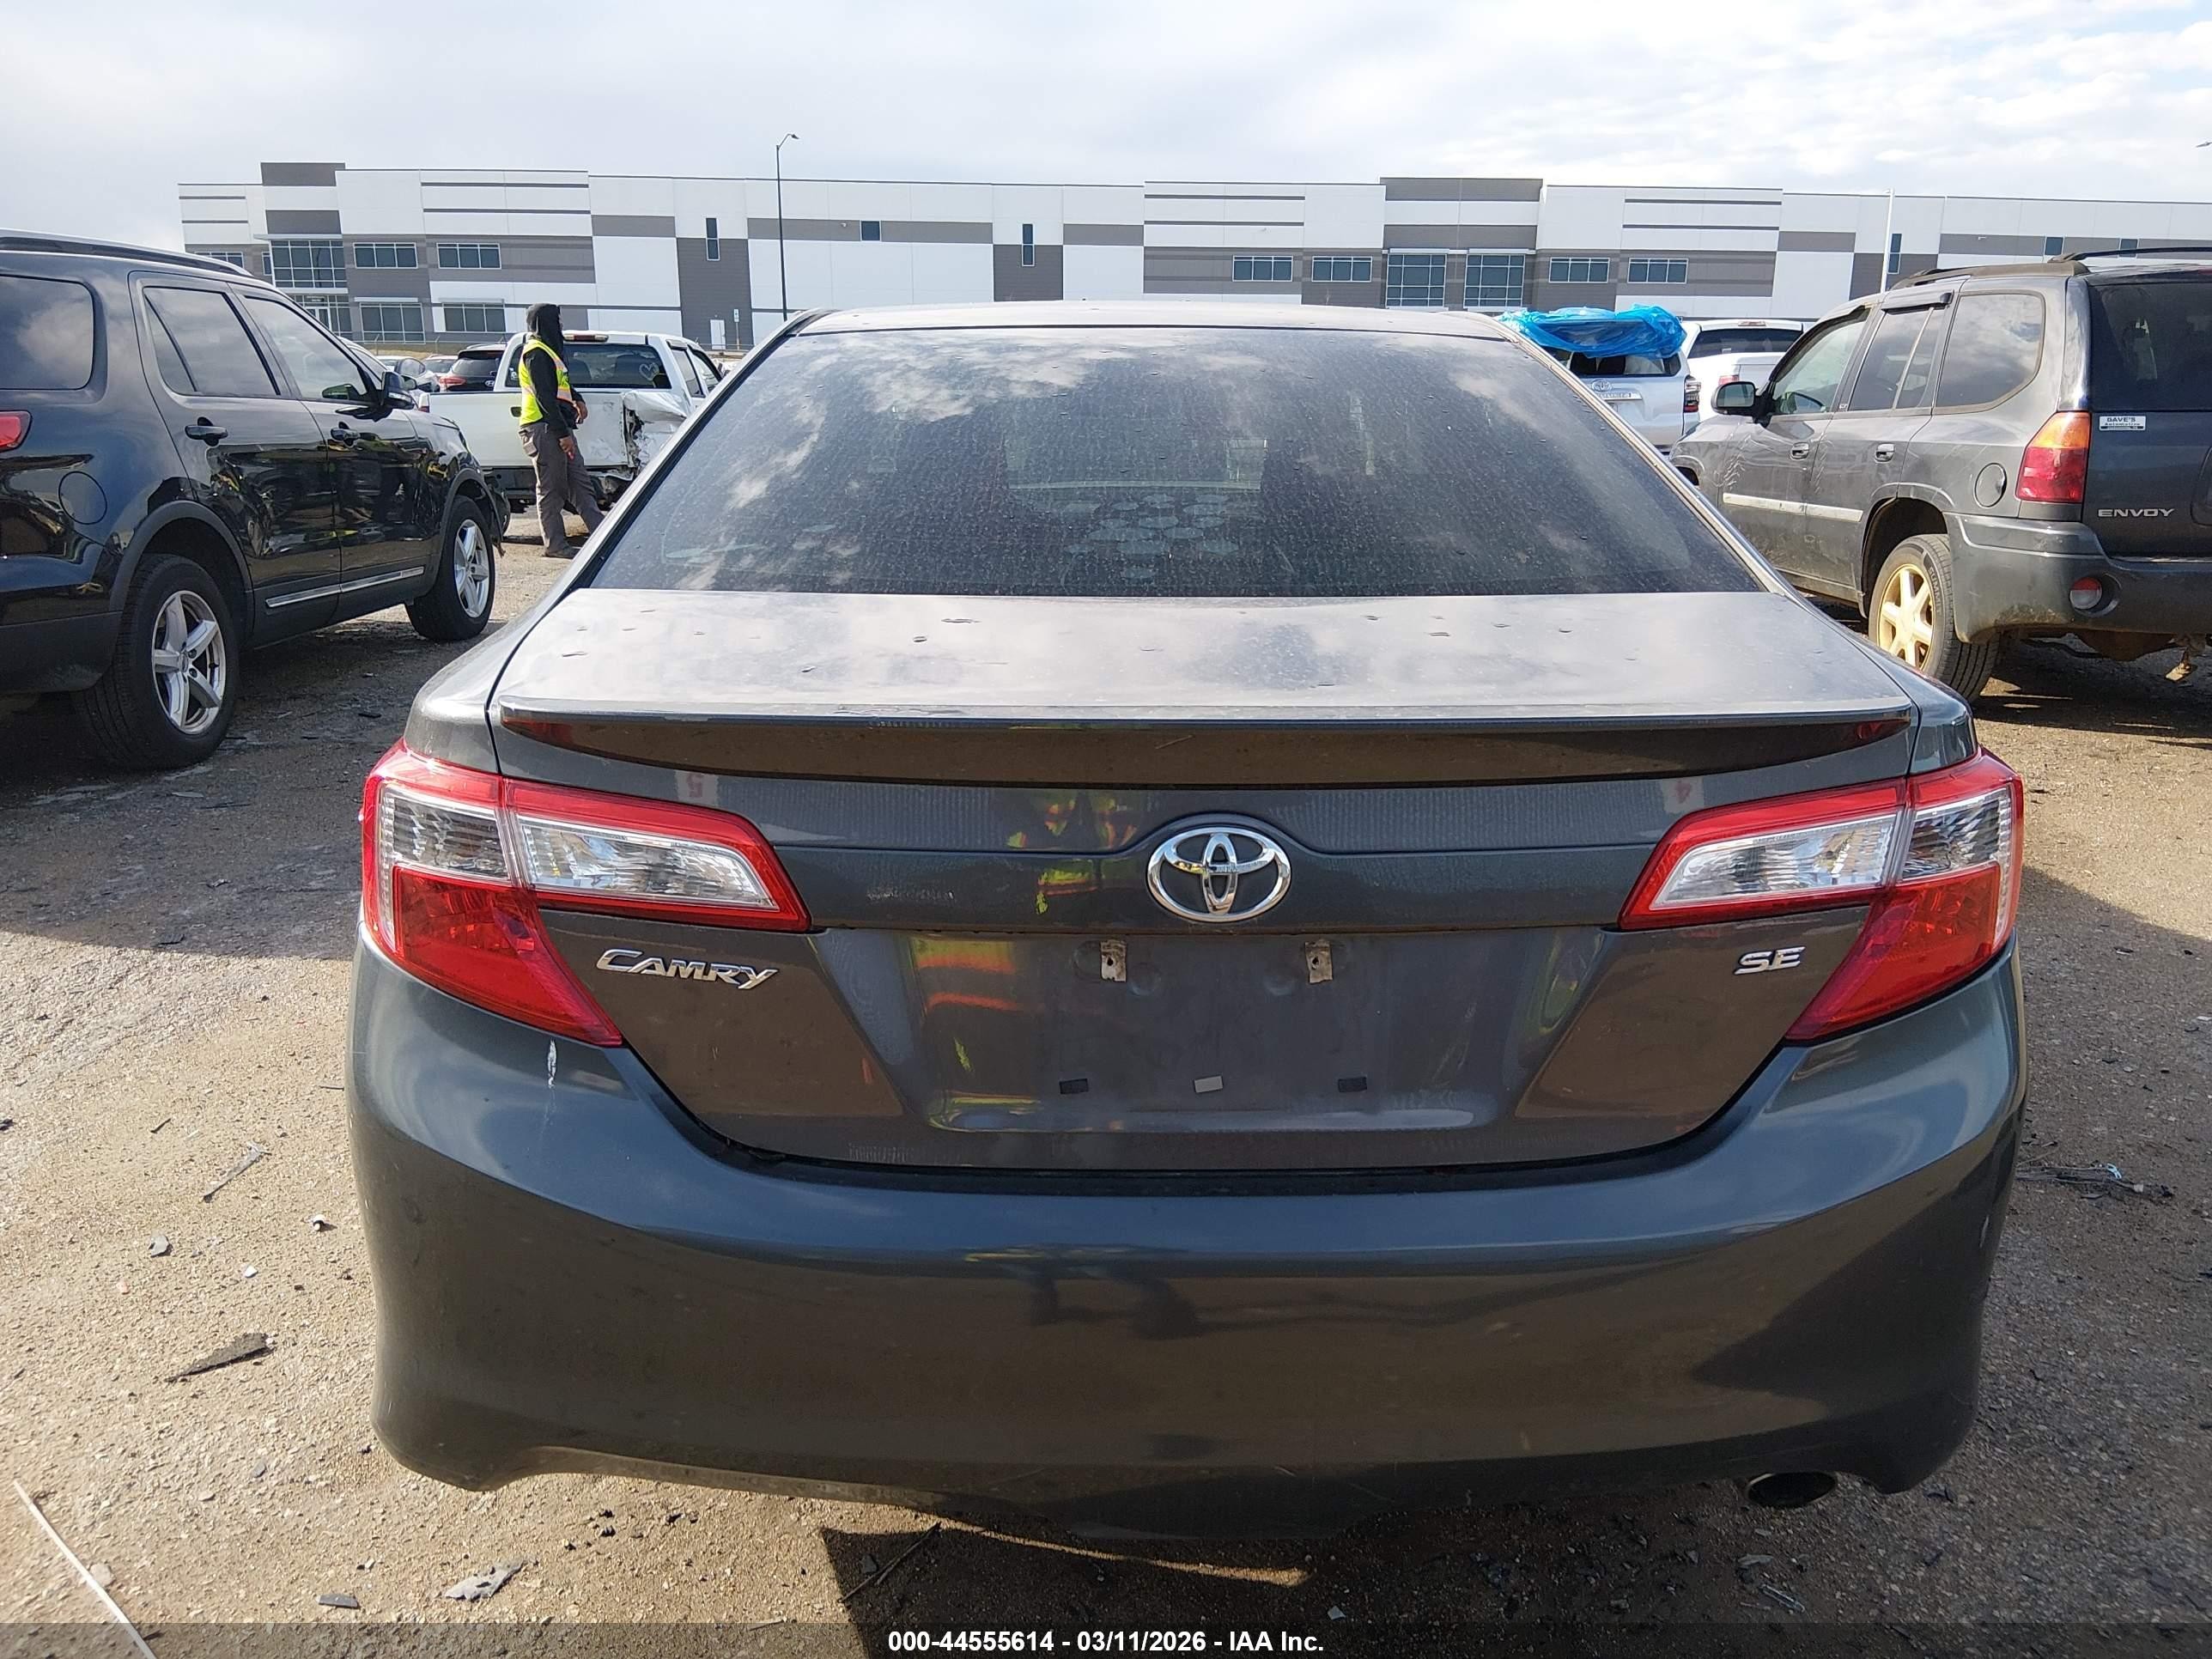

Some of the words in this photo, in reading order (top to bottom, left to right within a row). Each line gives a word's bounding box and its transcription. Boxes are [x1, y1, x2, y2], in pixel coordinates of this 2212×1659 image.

[2098, 508, 2175, 517] ENVOY
[596, 948, 778, 989] CAMRY
[1734, 946, 1806, 975] SE
